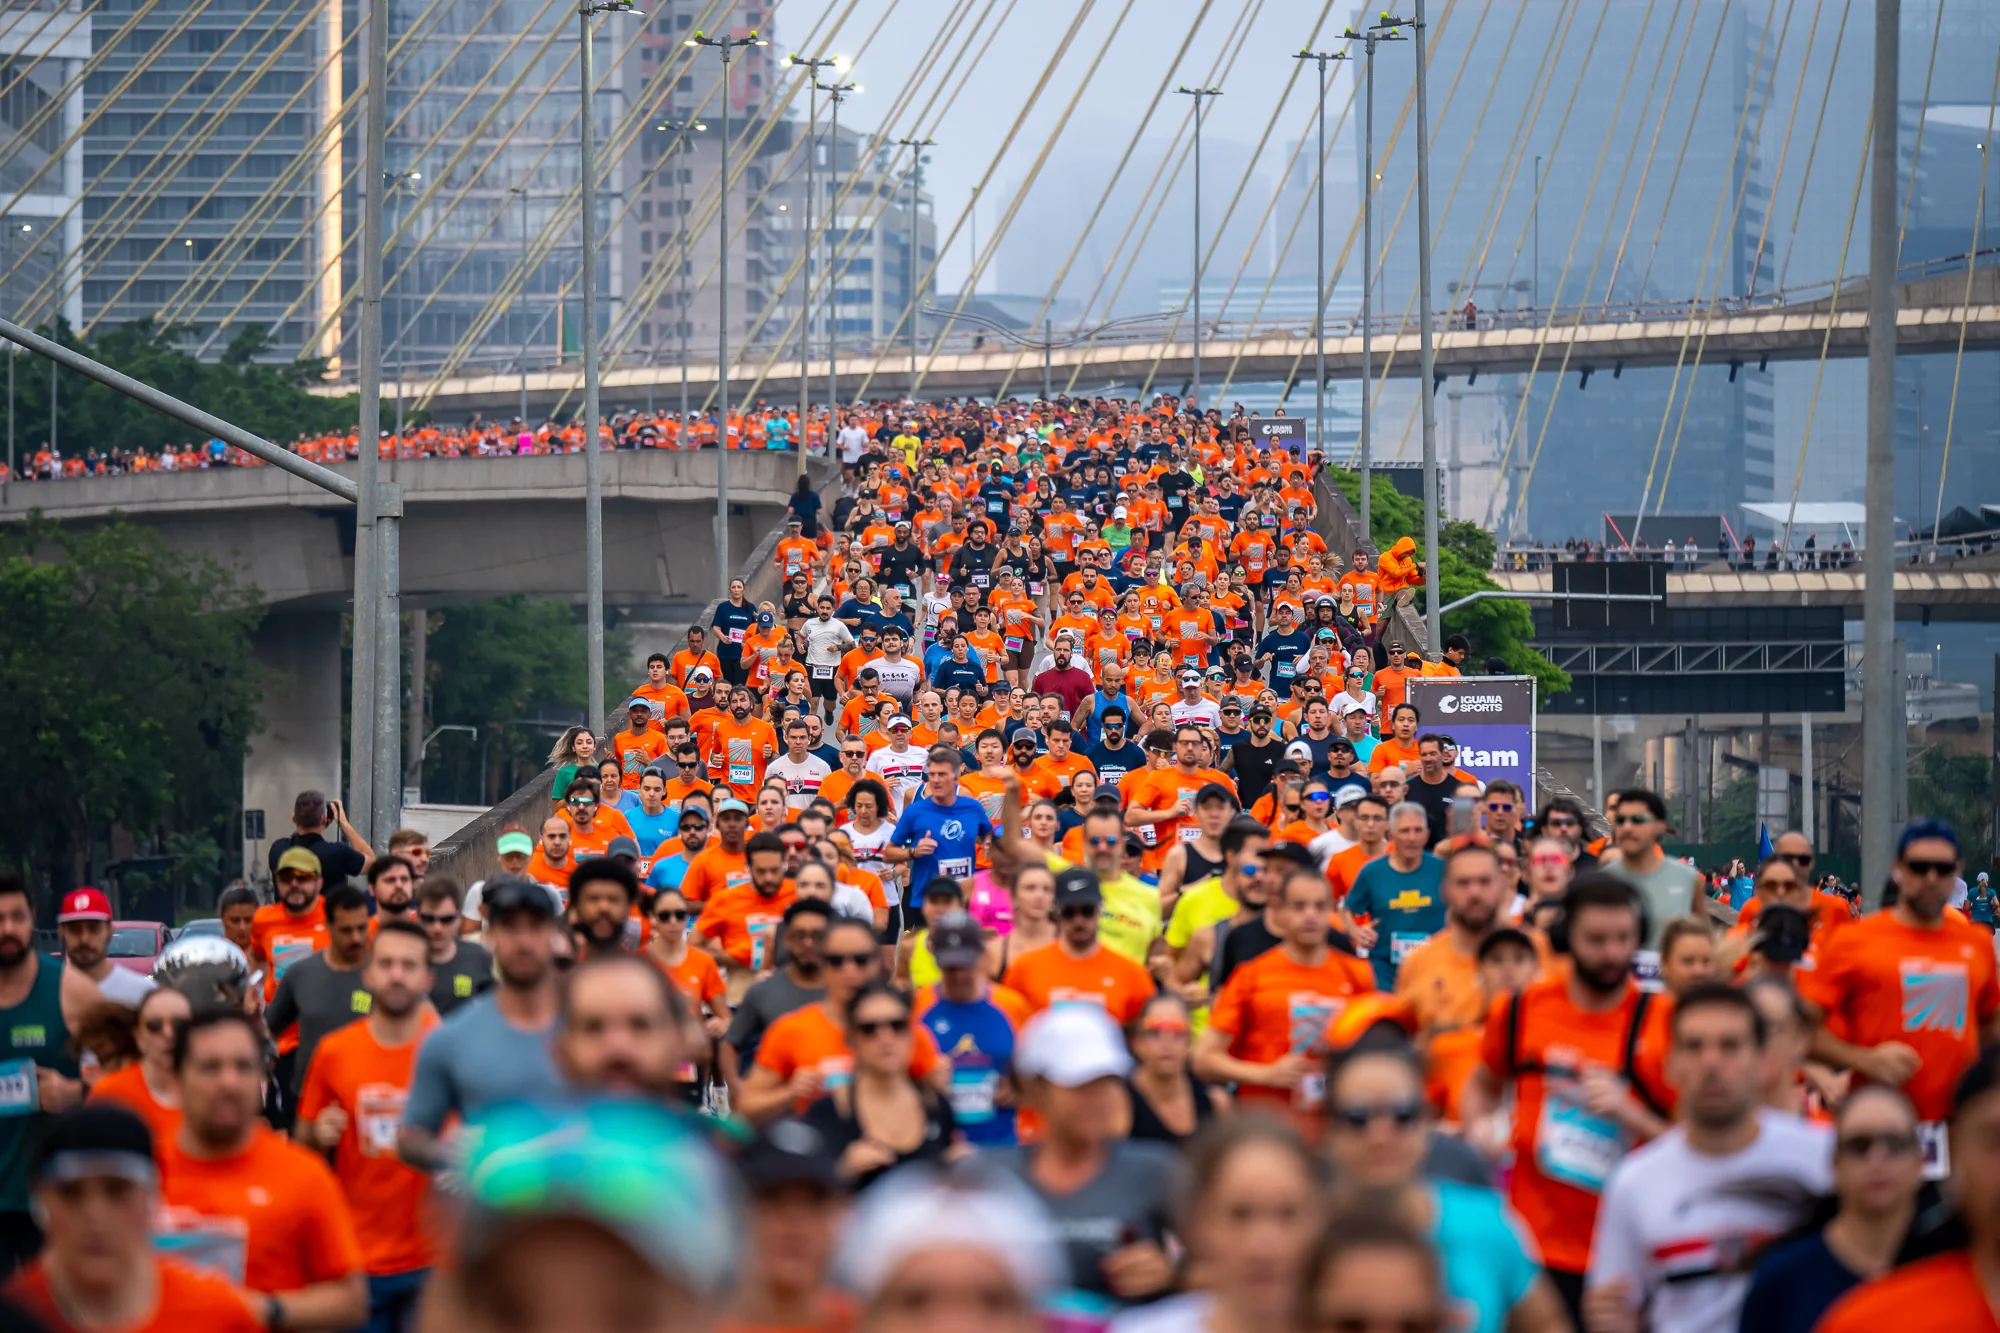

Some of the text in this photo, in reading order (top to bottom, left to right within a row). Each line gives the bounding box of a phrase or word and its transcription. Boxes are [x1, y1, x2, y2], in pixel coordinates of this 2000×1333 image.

[1460, 695, 1502, 704] IGUANA
[1460, 703, 1502, 712] SPORTS
[1455, 744, 1519, 767] ltam
